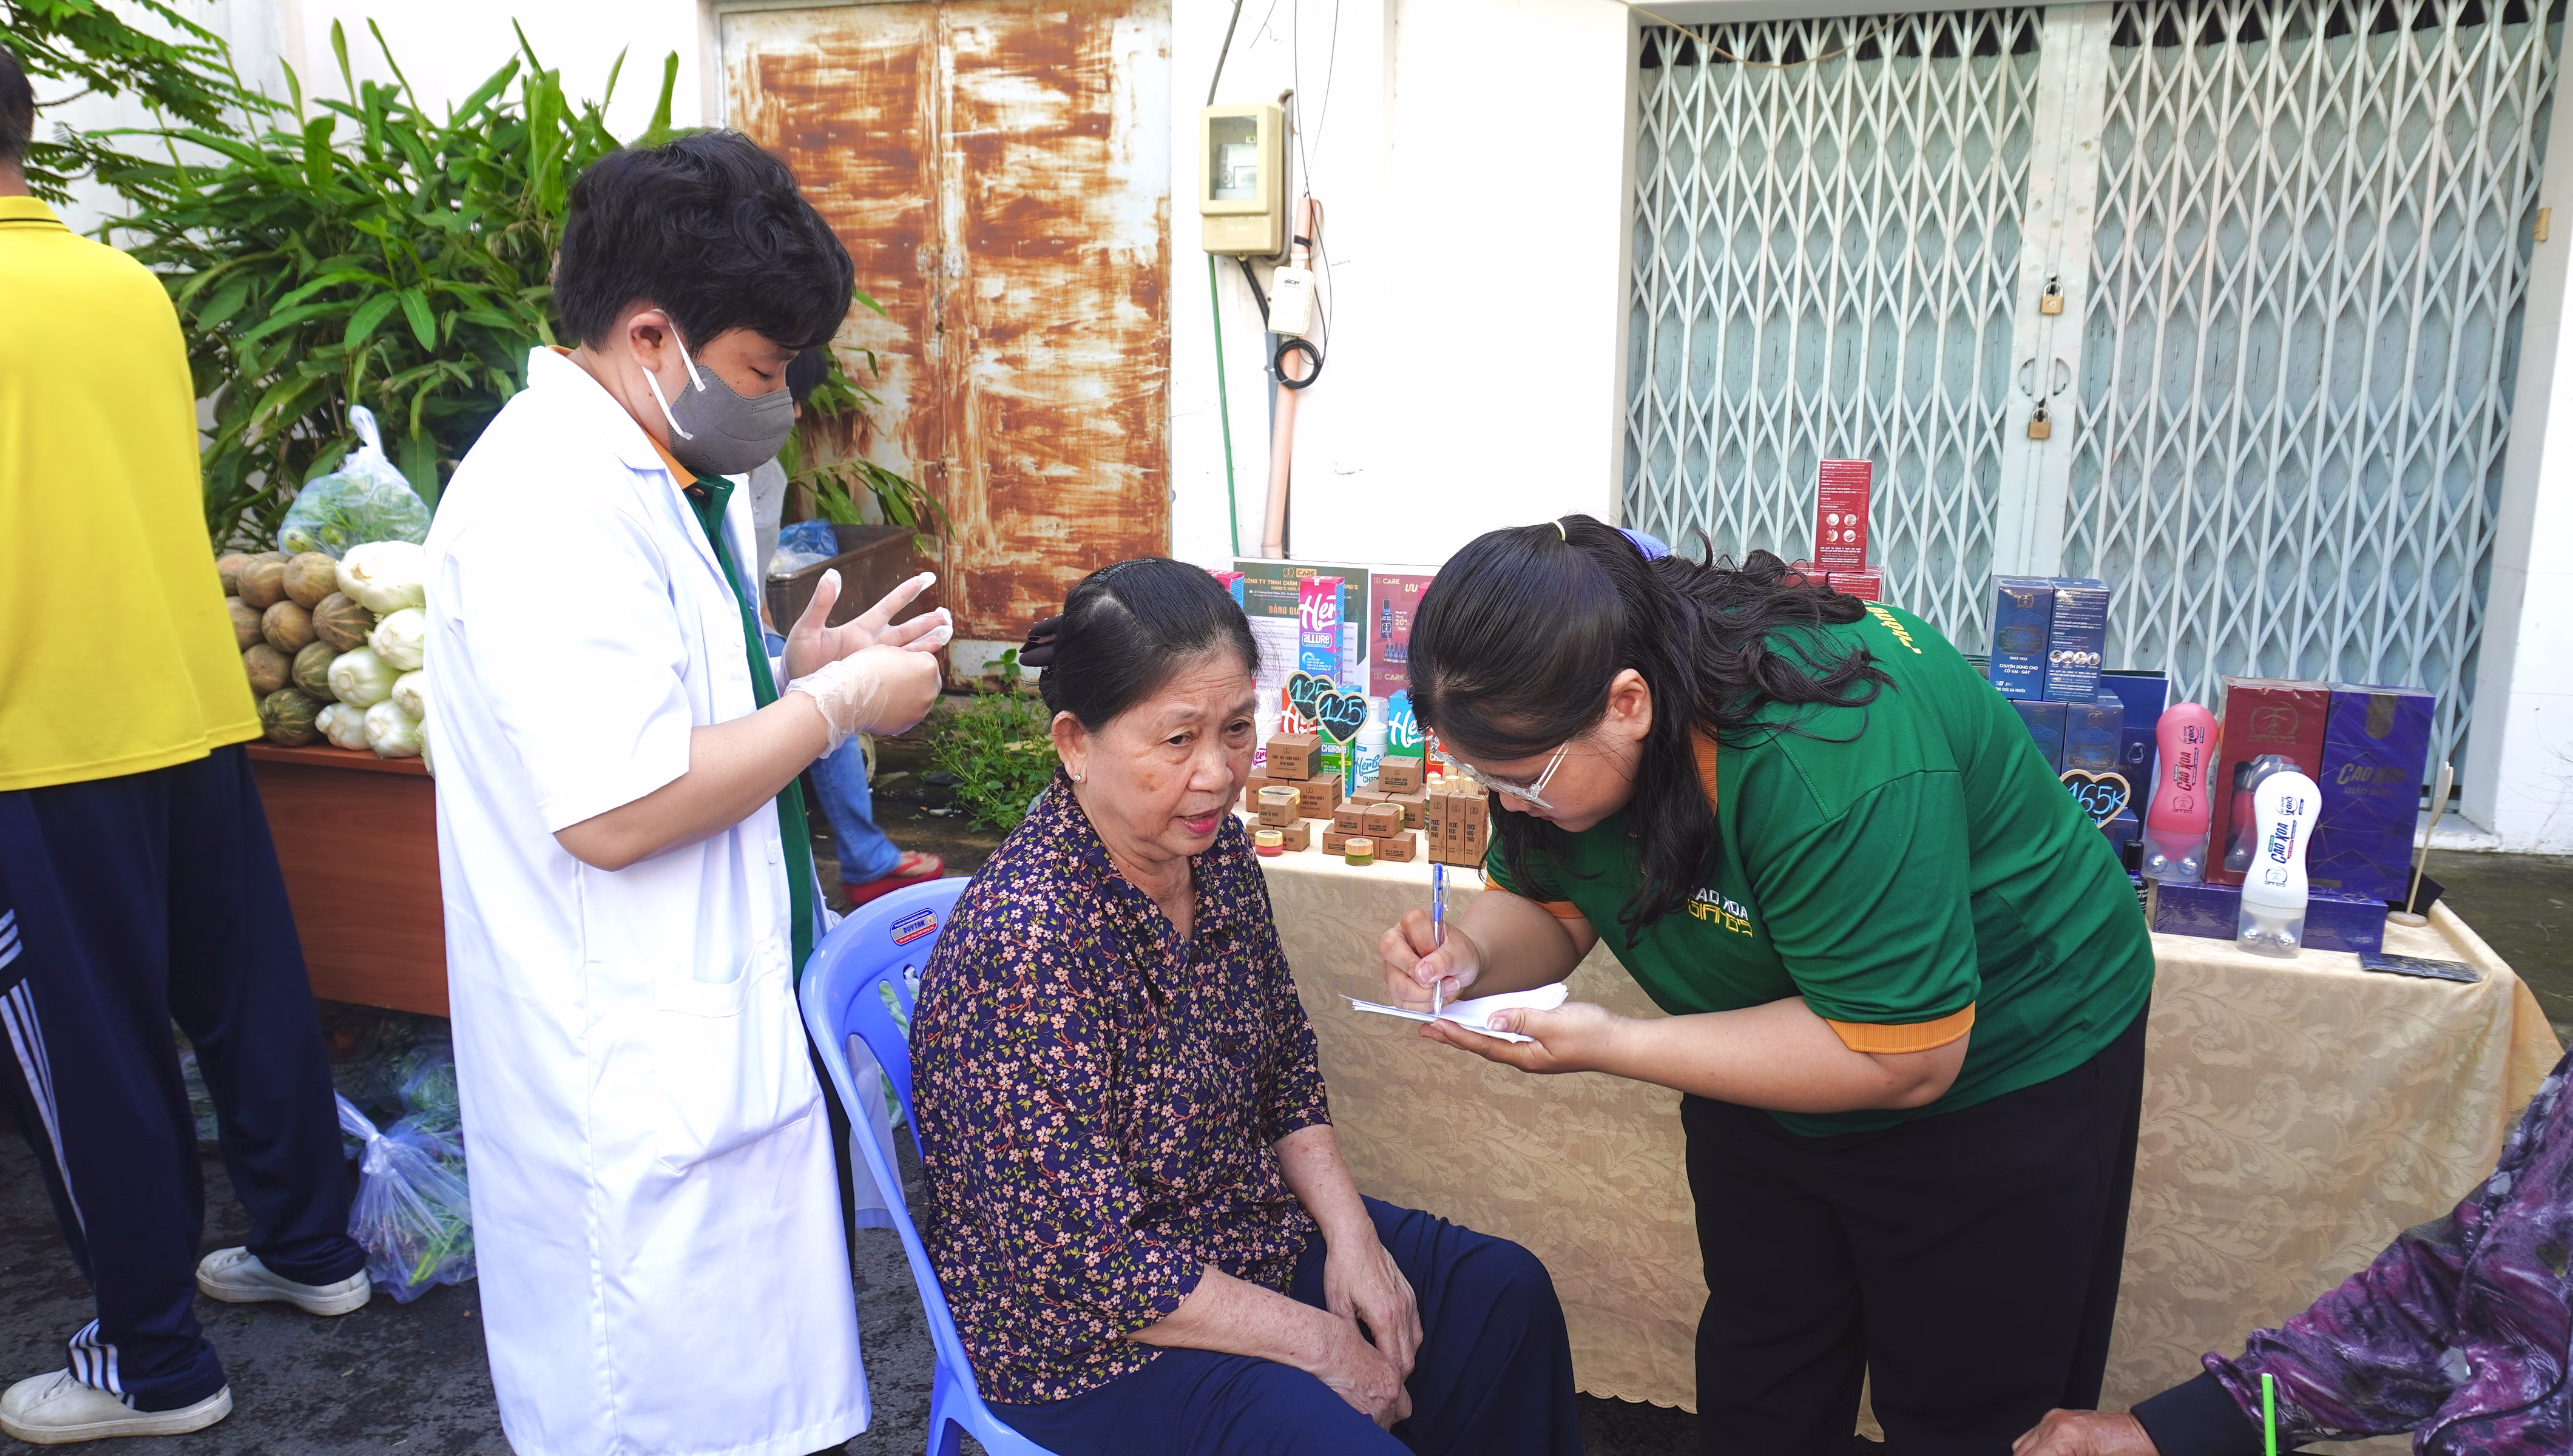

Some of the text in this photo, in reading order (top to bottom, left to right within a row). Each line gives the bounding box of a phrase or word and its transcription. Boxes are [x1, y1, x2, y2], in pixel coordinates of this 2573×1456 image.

[1268, 604, 1287, 615] BẢNG
[2177, 752, 2193, 791] CAO XOA
[2337, 763, 2373, 785] CAO
[2271, 822, 2290, 864] CAO XOA
[1695, 888, 1749, 921] AO XOA
